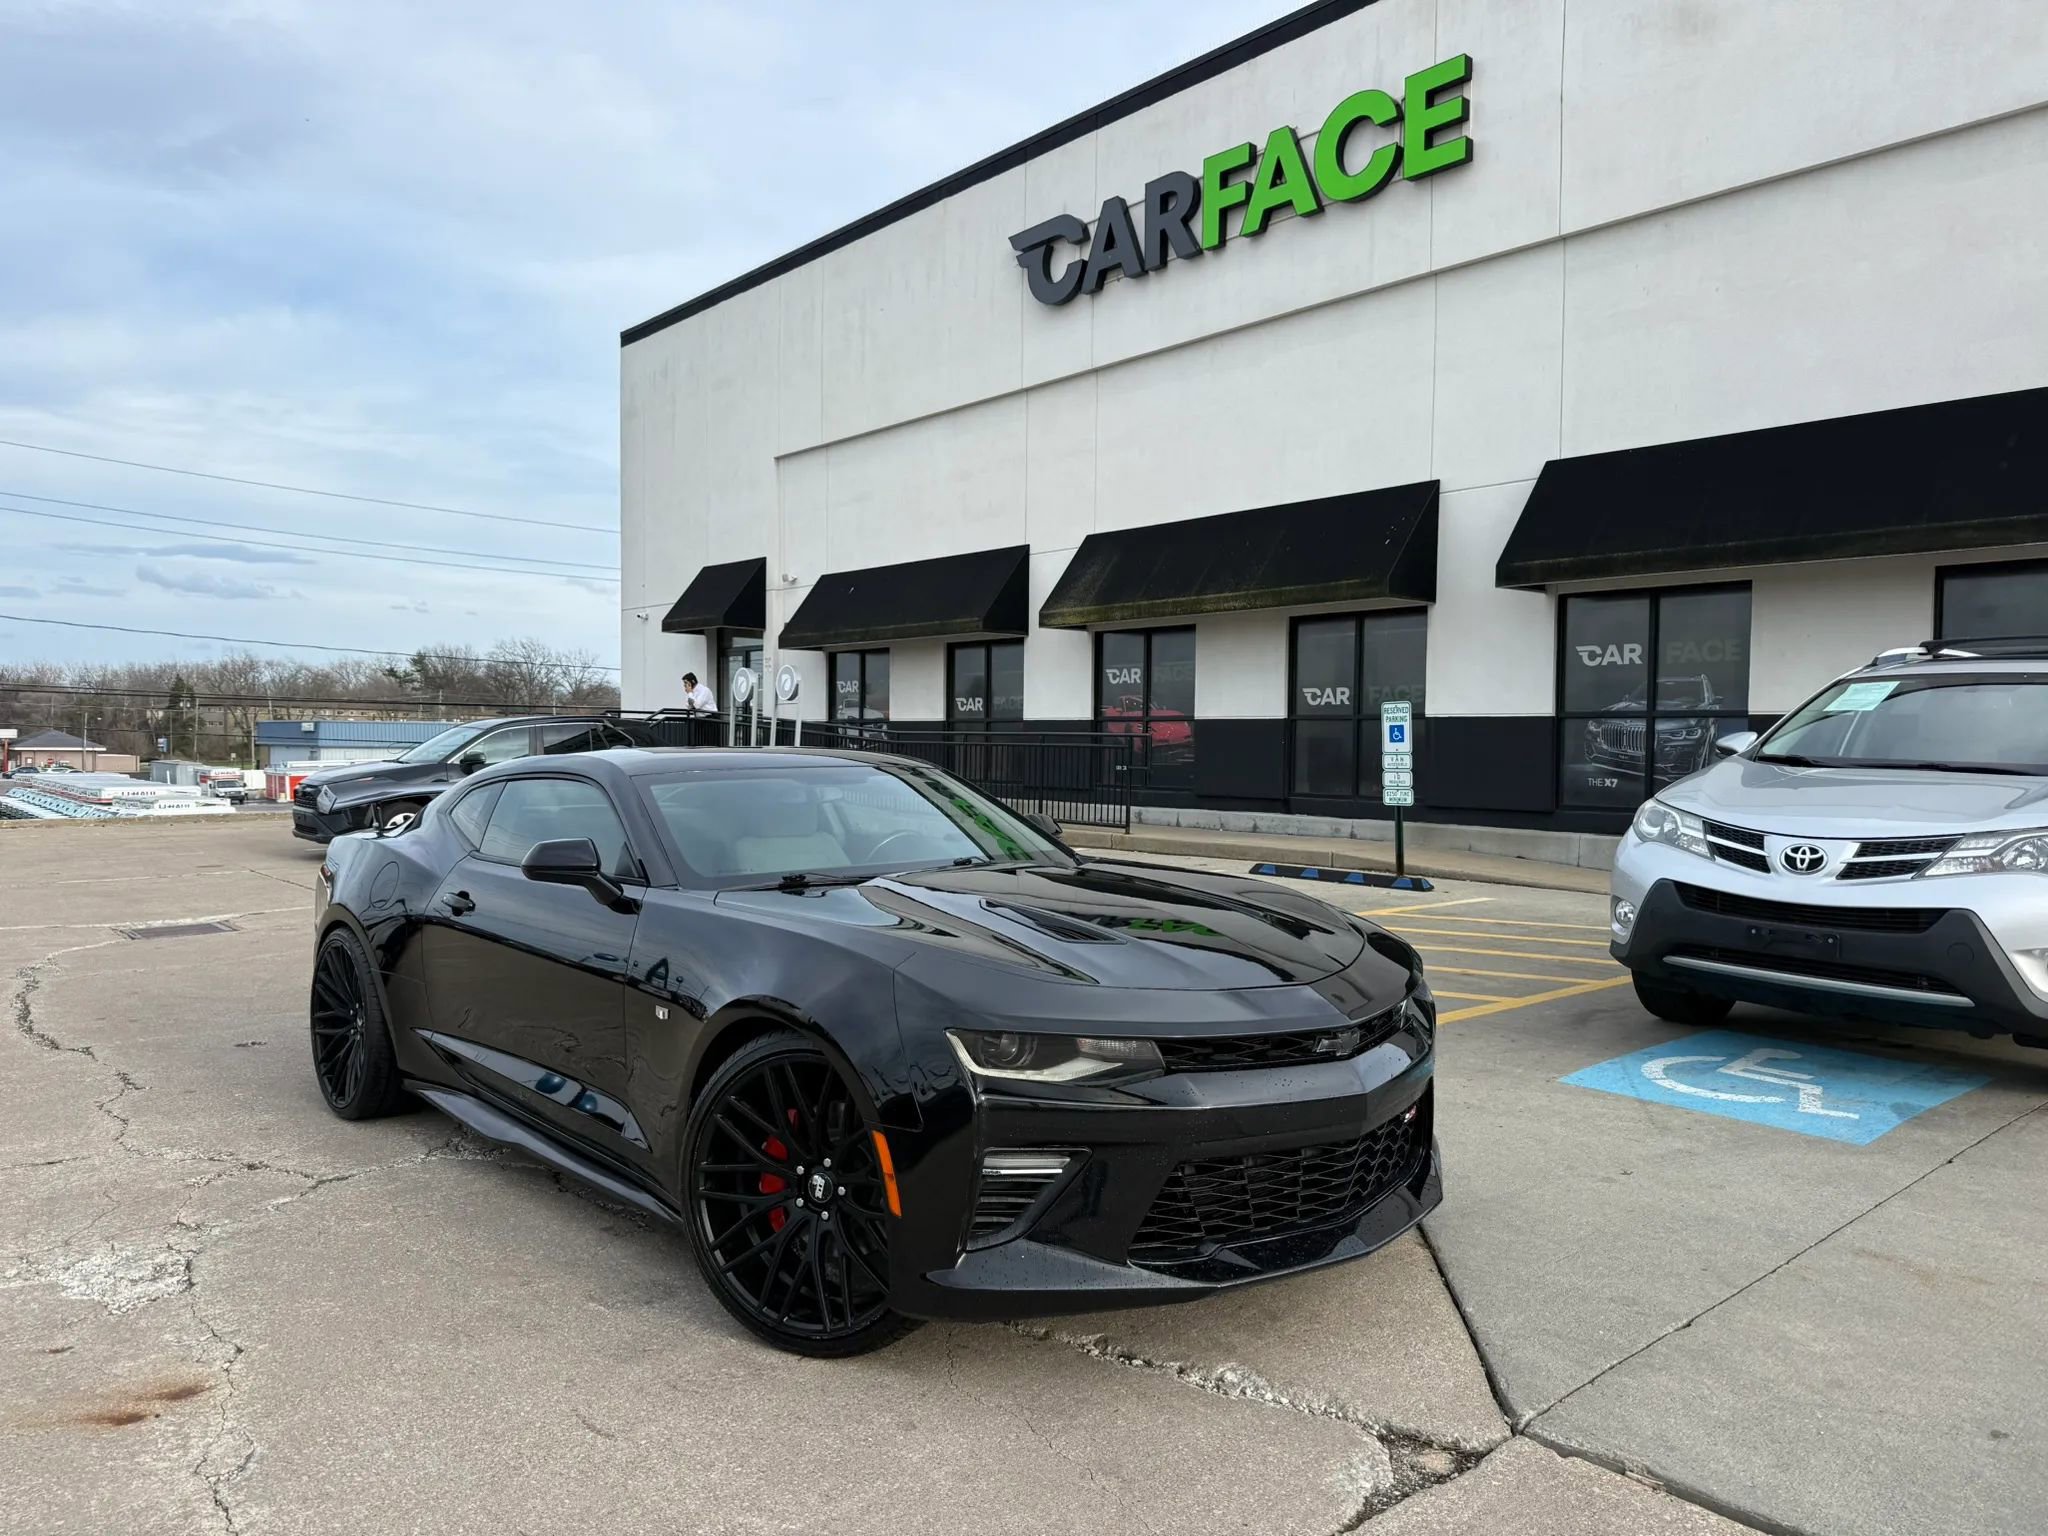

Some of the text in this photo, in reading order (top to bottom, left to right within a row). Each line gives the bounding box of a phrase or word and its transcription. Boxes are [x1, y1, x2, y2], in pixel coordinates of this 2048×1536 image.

[1576, 639, 1744, 667] CAR FACE
[1105, 668, 1141, 684] CAR
[837, 681, 859, 693] CAR
[1302, 687, 1350, 705] CAR
[955, 697, 983, 712] CAR
[1384, 706, 1409, 714] RESERVED
[1588, 778, 1618, 788] THE X7
